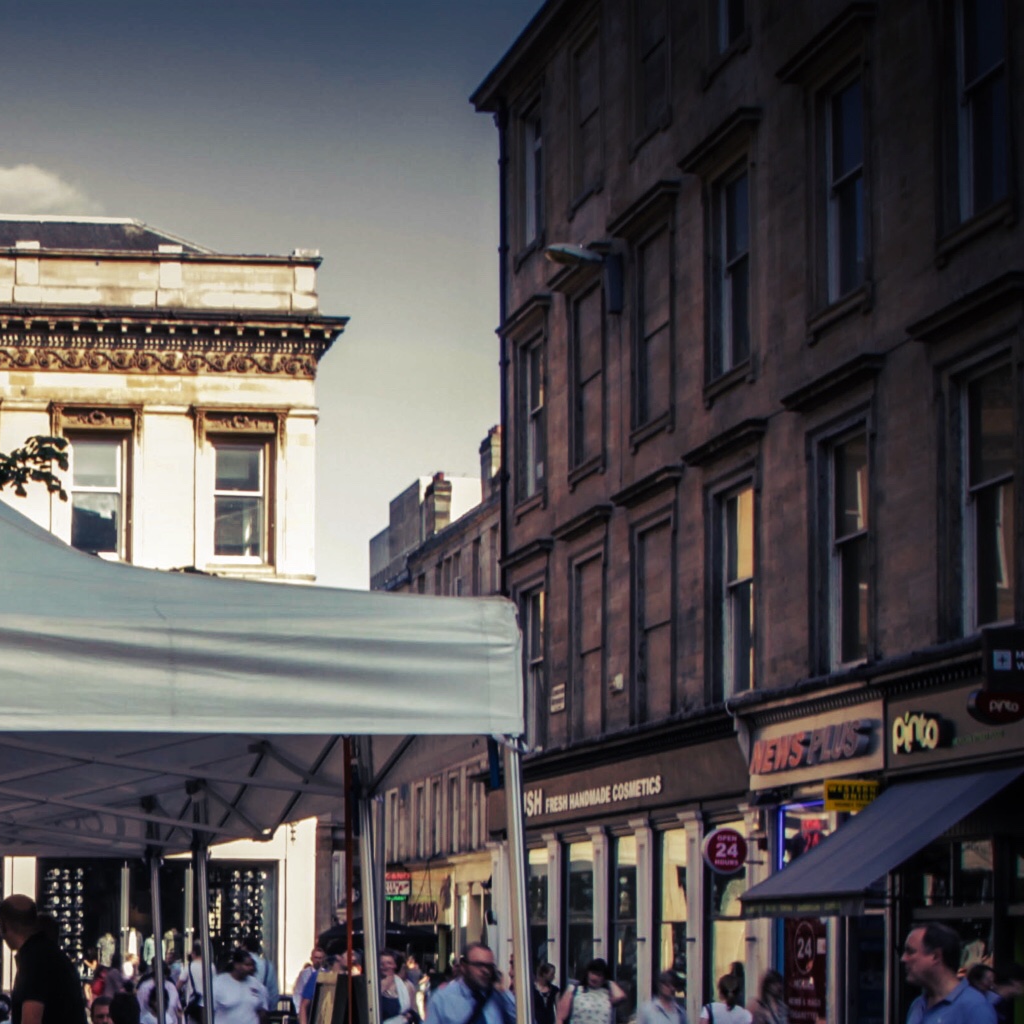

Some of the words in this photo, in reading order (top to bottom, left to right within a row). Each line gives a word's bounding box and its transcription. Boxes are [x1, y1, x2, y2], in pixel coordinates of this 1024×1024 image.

[749, 731, 806, 775] NEWS
[806, 720, 862, 765] PLUS
[892, 710, 939, 755] pinto
[523, 788, 543, 817] SH
[545, 794, 568, 814] FRESH
[569, 785, 611, 810] HANDMADE
[612, 775, 662, 802] COSMETICS
[715, 842, 739, 858] 24
[797, 937, 812, 959] 24
